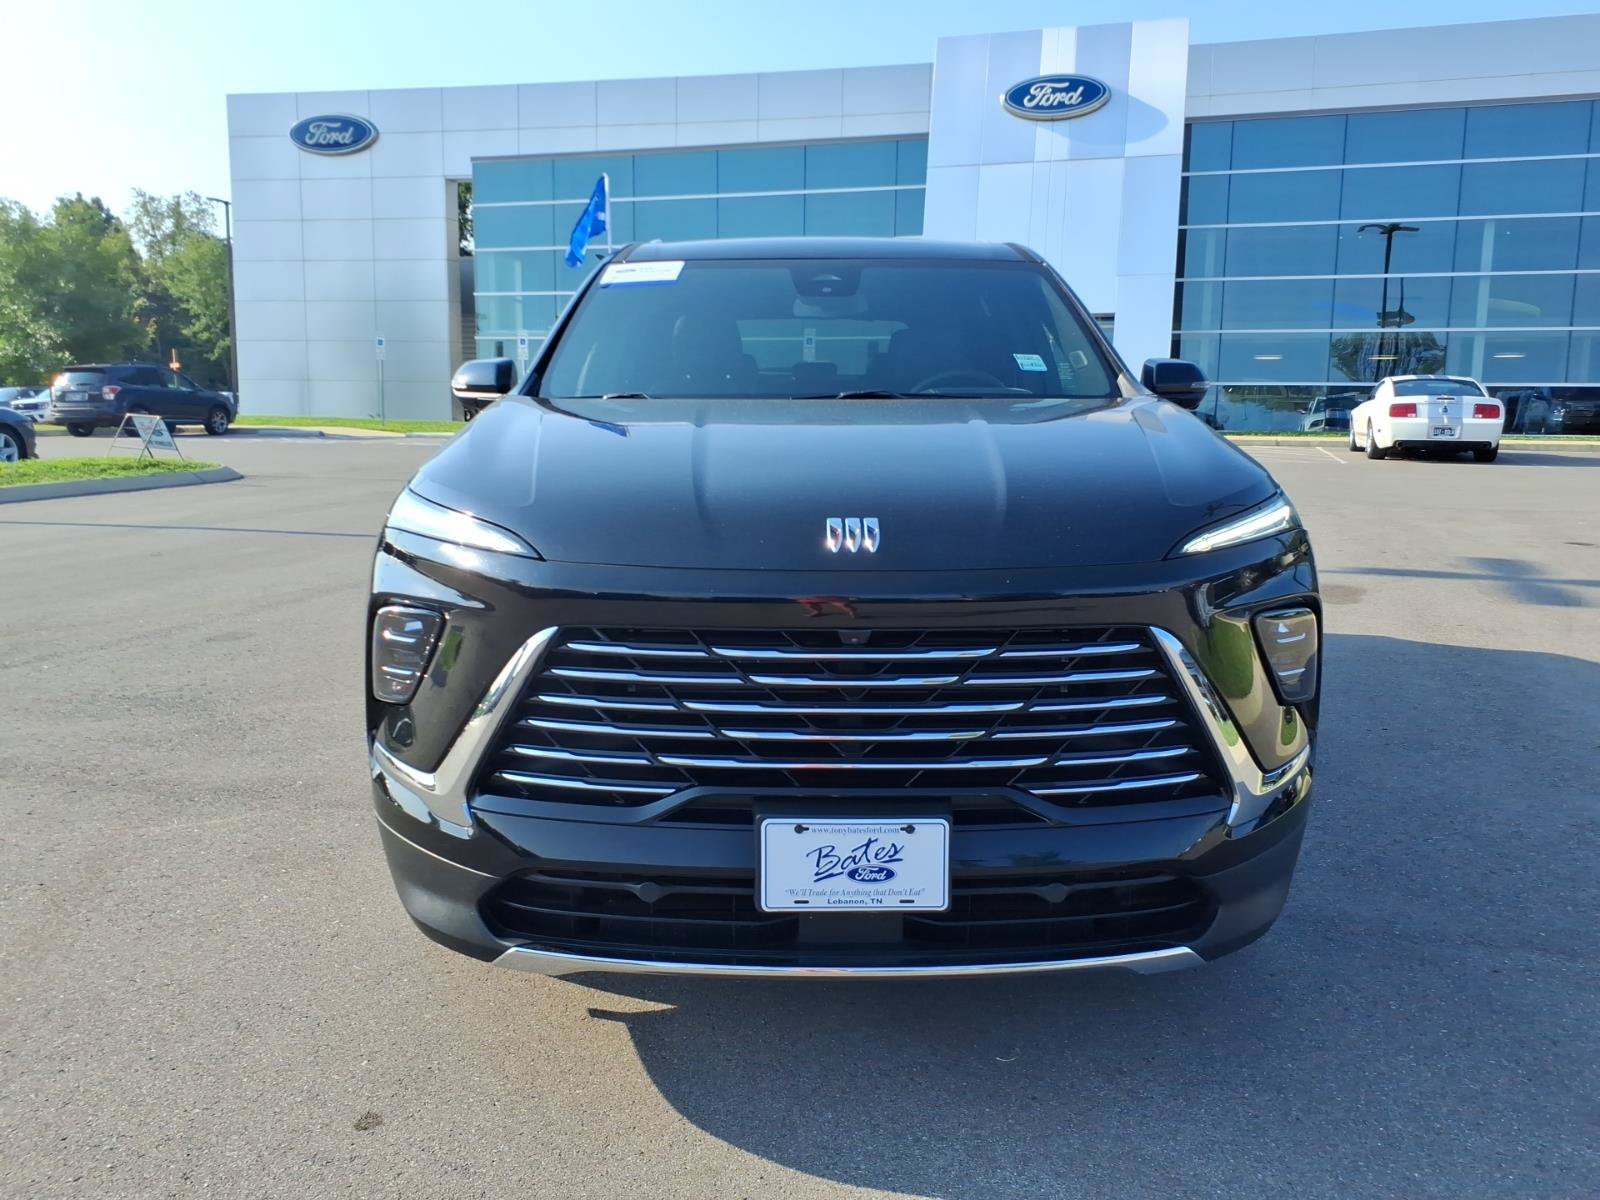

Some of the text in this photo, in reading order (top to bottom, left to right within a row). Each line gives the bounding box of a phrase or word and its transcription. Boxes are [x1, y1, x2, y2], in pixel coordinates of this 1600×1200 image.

[1023, 82, 1085, 108] Ford
[304, 121, 355, 145] Ford
[811, 826, 900, 834] www.tonybatesford.com
[806, 837, 905, 877] Bates
[854, 867, 886, 881] Ford
[808, 888, 827, 896] Trade
[828, 888, 840, 897] for
[840, 888, 872, 897] Anything
[873, 887, 887, 896] that
[888, 887, 907, 896] Don't
